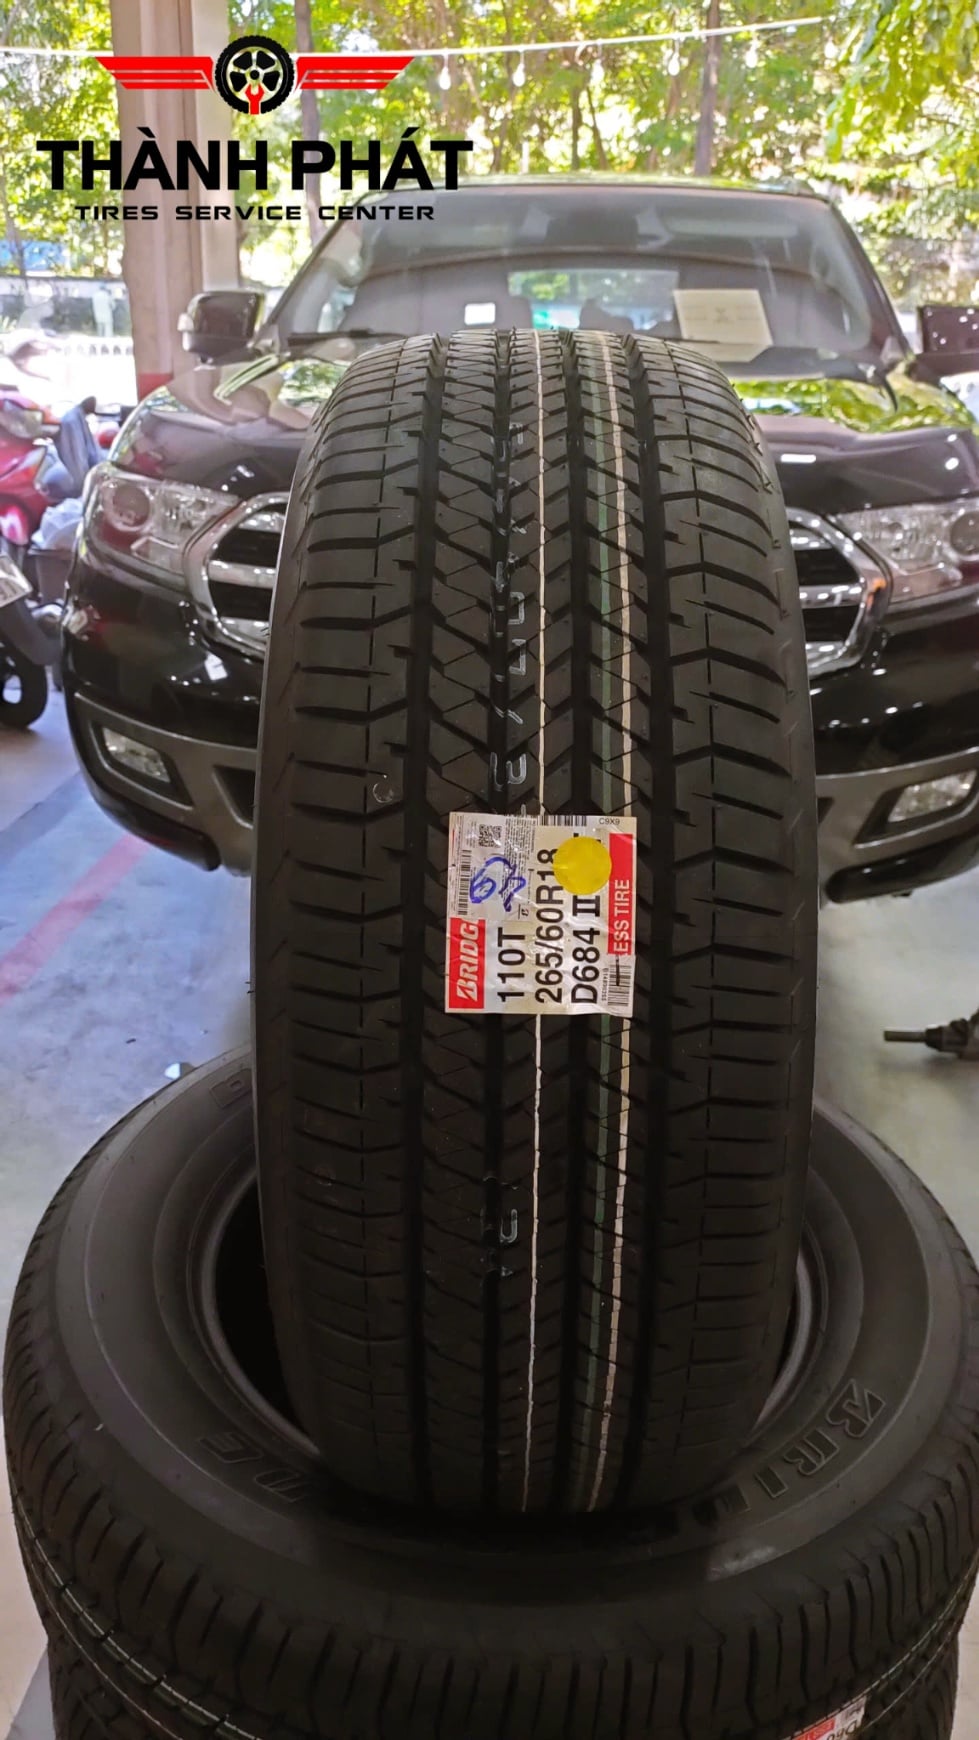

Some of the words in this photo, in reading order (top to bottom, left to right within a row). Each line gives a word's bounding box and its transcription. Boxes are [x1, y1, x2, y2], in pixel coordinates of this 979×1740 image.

[534, 848, 564, 1004] 265/60R18
[614, 879, 630, 918] TIRE
[497, 926, 526, 1003] 110T
[571, 927, 600, 1004] D684
